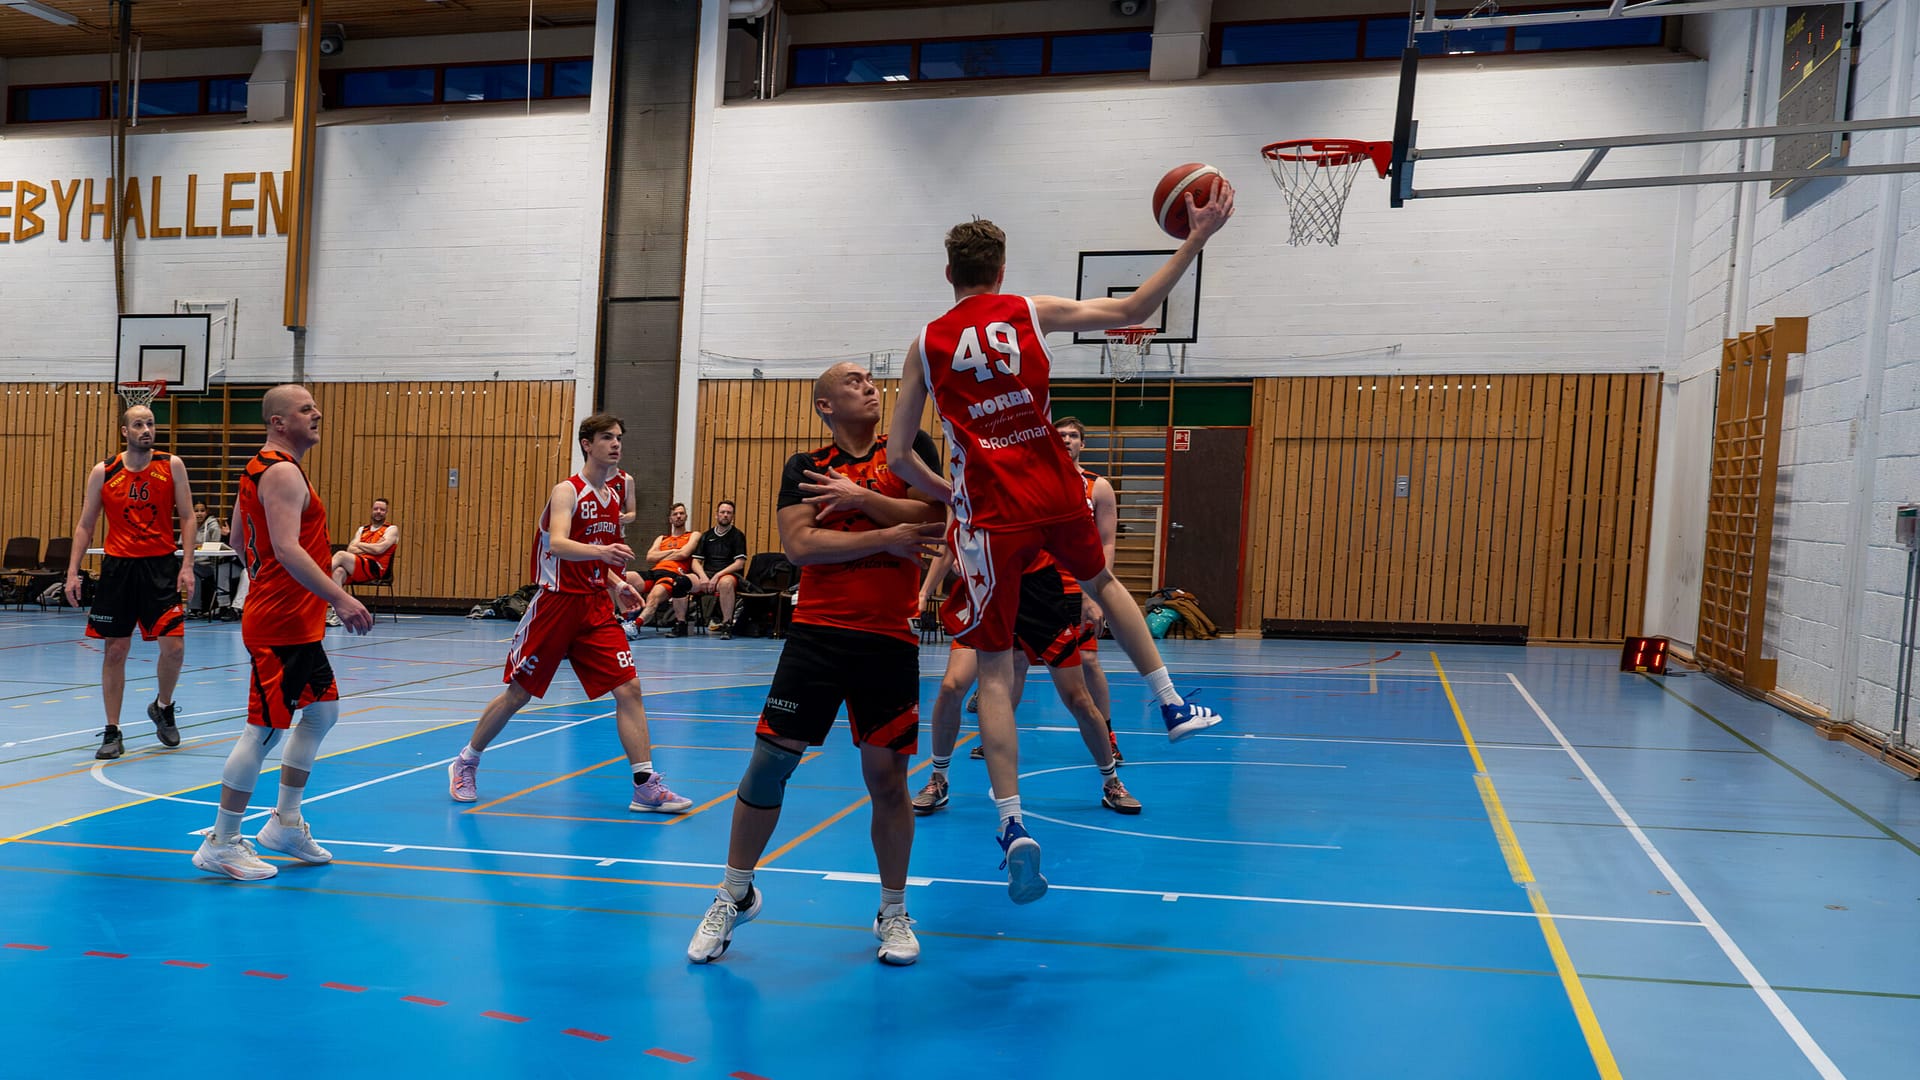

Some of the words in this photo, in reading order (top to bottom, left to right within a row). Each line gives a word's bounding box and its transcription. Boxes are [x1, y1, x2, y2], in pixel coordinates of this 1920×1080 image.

[952, 322, 1020, 382] 49
[967, 388, 1034, 420] NORBI
[128, 482, 149, 501] 46
[581, 500, 599, 520] 82
[616, 650, 635, 669] 82
